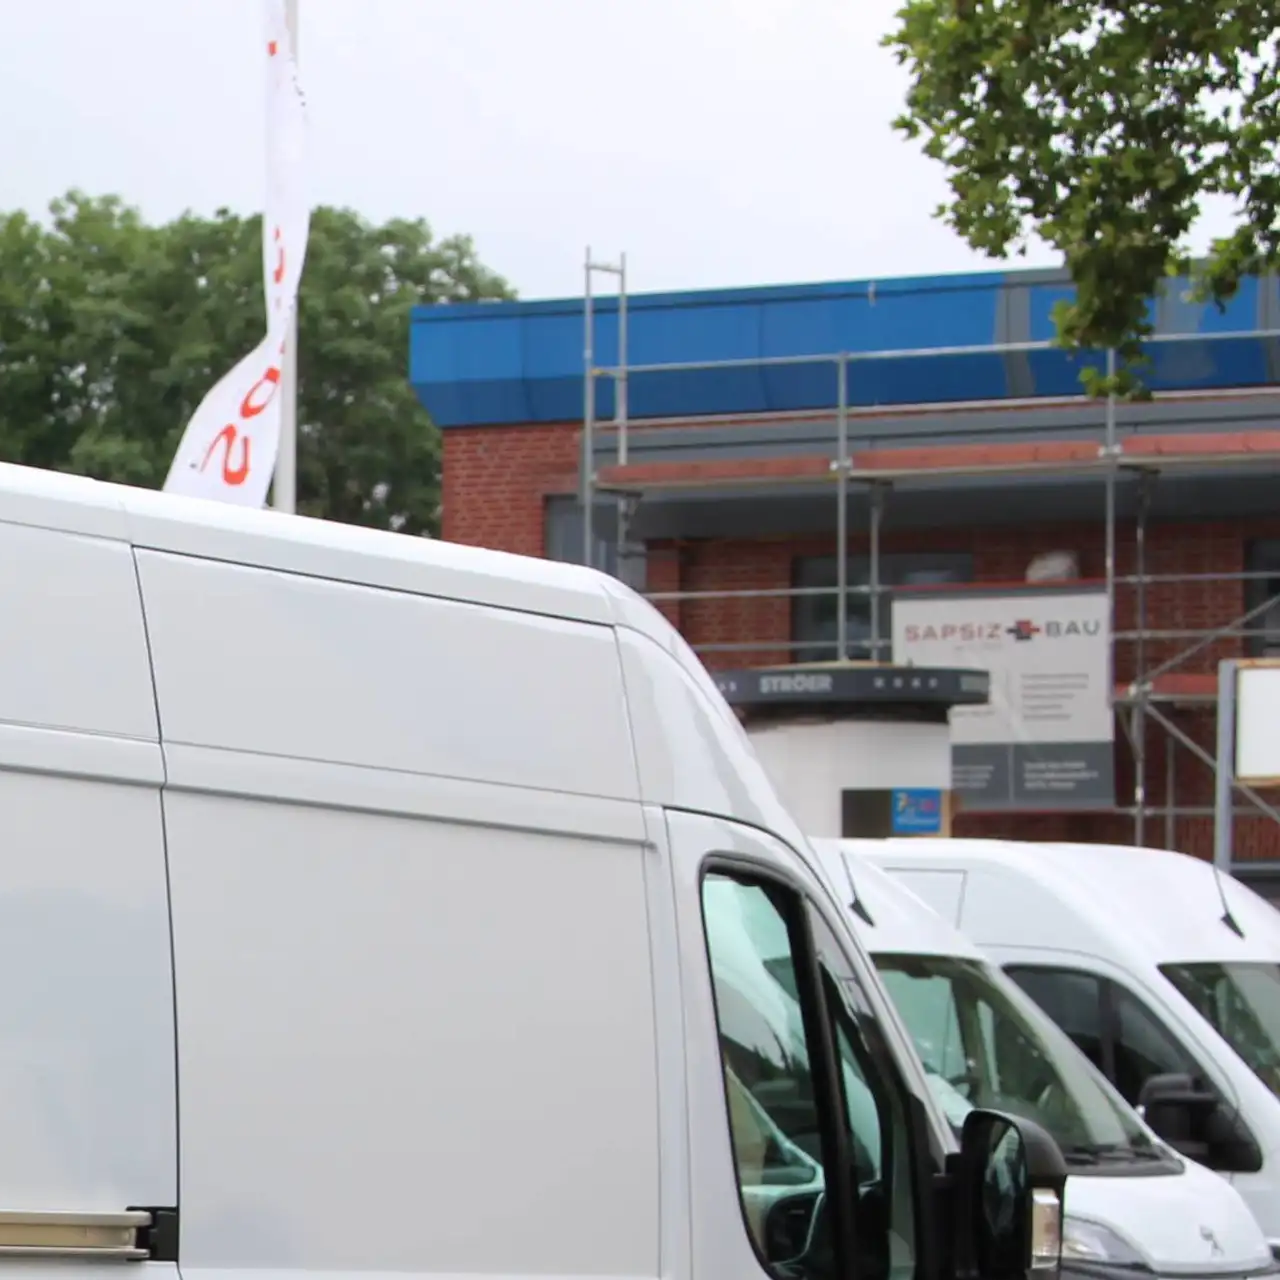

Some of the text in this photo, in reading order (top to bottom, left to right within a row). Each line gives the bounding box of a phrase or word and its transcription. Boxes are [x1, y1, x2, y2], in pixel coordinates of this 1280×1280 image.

[905, 620, 1100, 641] SAPSIZ BAU
[760, 673, 833, 692] STRÖER
